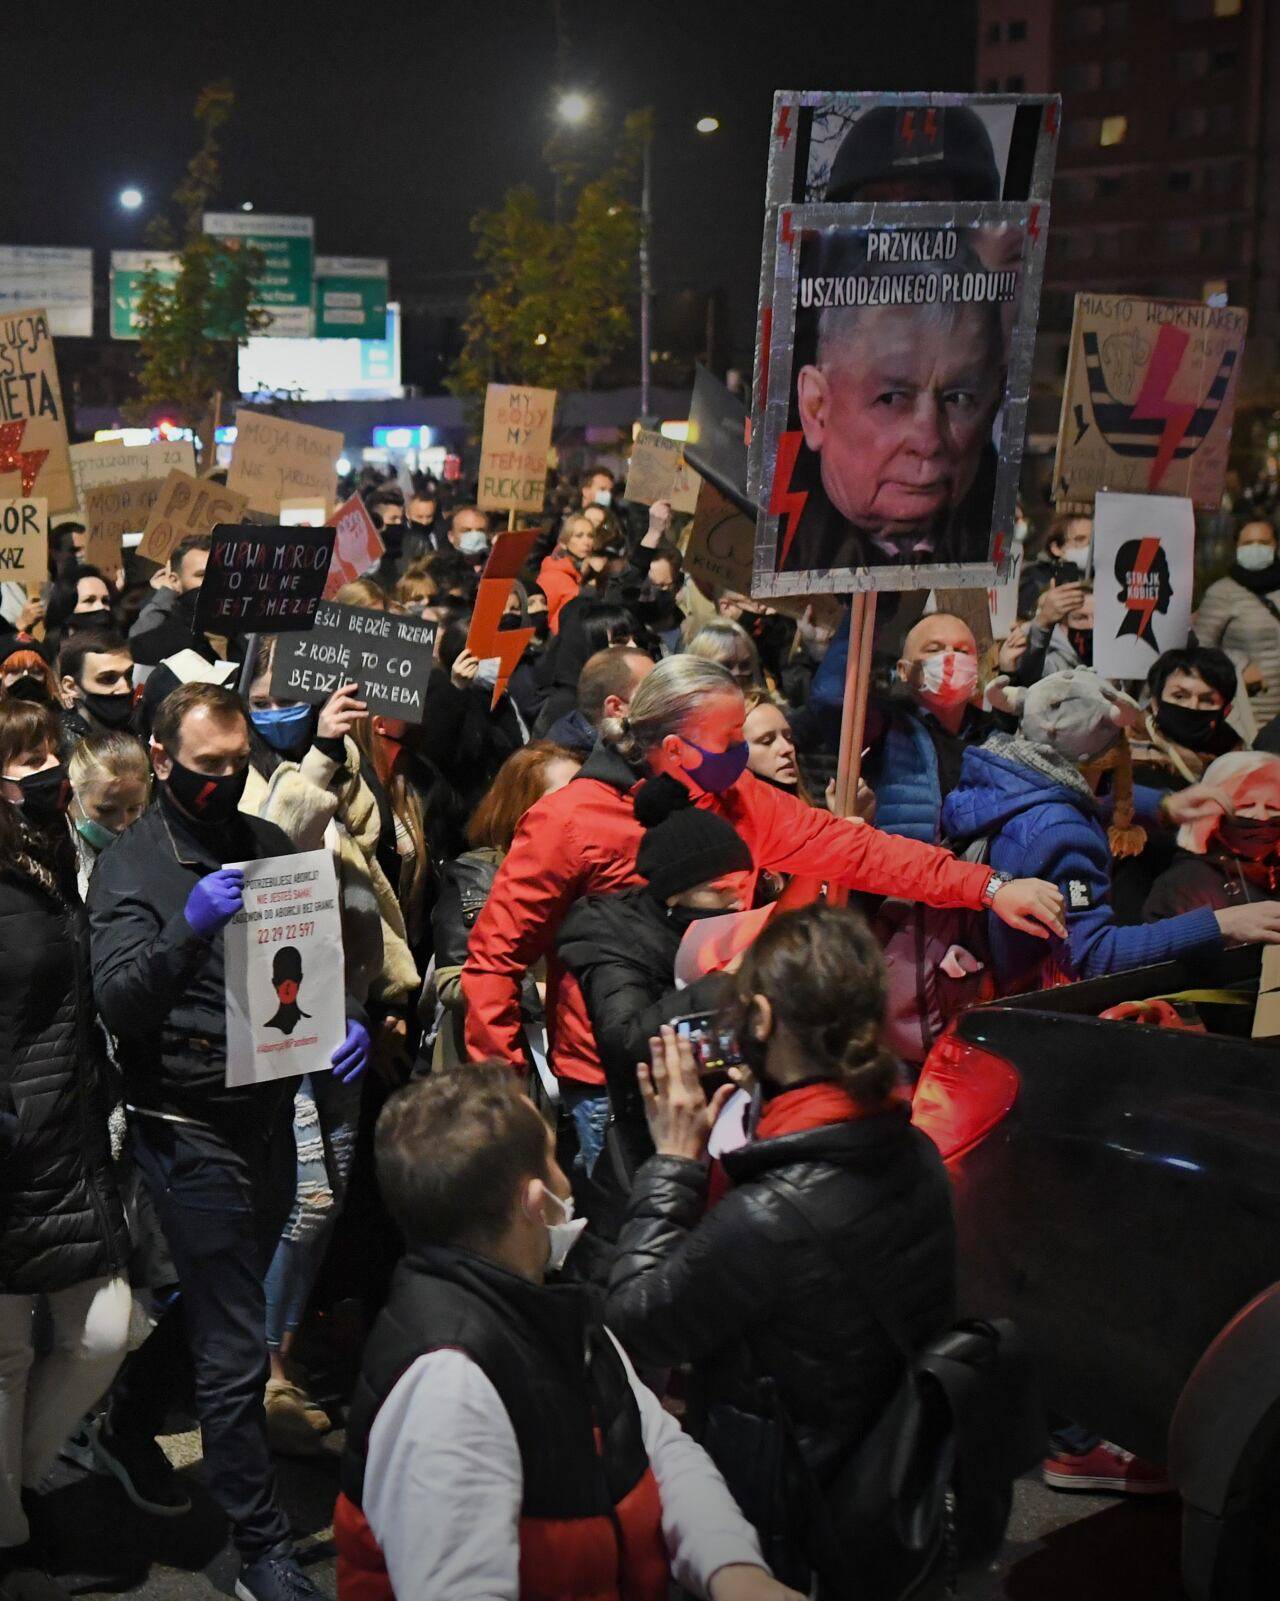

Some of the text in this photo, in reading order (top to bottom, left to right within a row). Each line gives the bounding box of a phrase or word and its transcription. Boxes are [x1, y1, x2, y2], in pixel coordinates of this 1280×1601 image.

[866, 231, 958, 263] PRZYKŁAD
[801, 271, 1017, 308] USZKODZONEGO PŁODU!!!
[1081, 298, 1133, 321] MIASTO
[508, 392, 531, 412] MY
[496, 407, 548, 428] BODY
[244, 422, 290, 455] MOJA
[506, 426, 532, 445] MY
[74, 454, 149, 477] praszamy
[483, 476, 545, 501] FUCK OFF
[1125, 570, 1161, 586] STRAJK
[1127, 586, 1160, 601] KOBIET
[314, 608, 434, 645] EŚLI BĘDZIE TRZEBA
[361, 650, 379, 670] TO
[386, 656, 412, 678] CO
[364, 679, 420, 708] TRZEBA
[258, 920, 315, 944] 22 29 22 597
